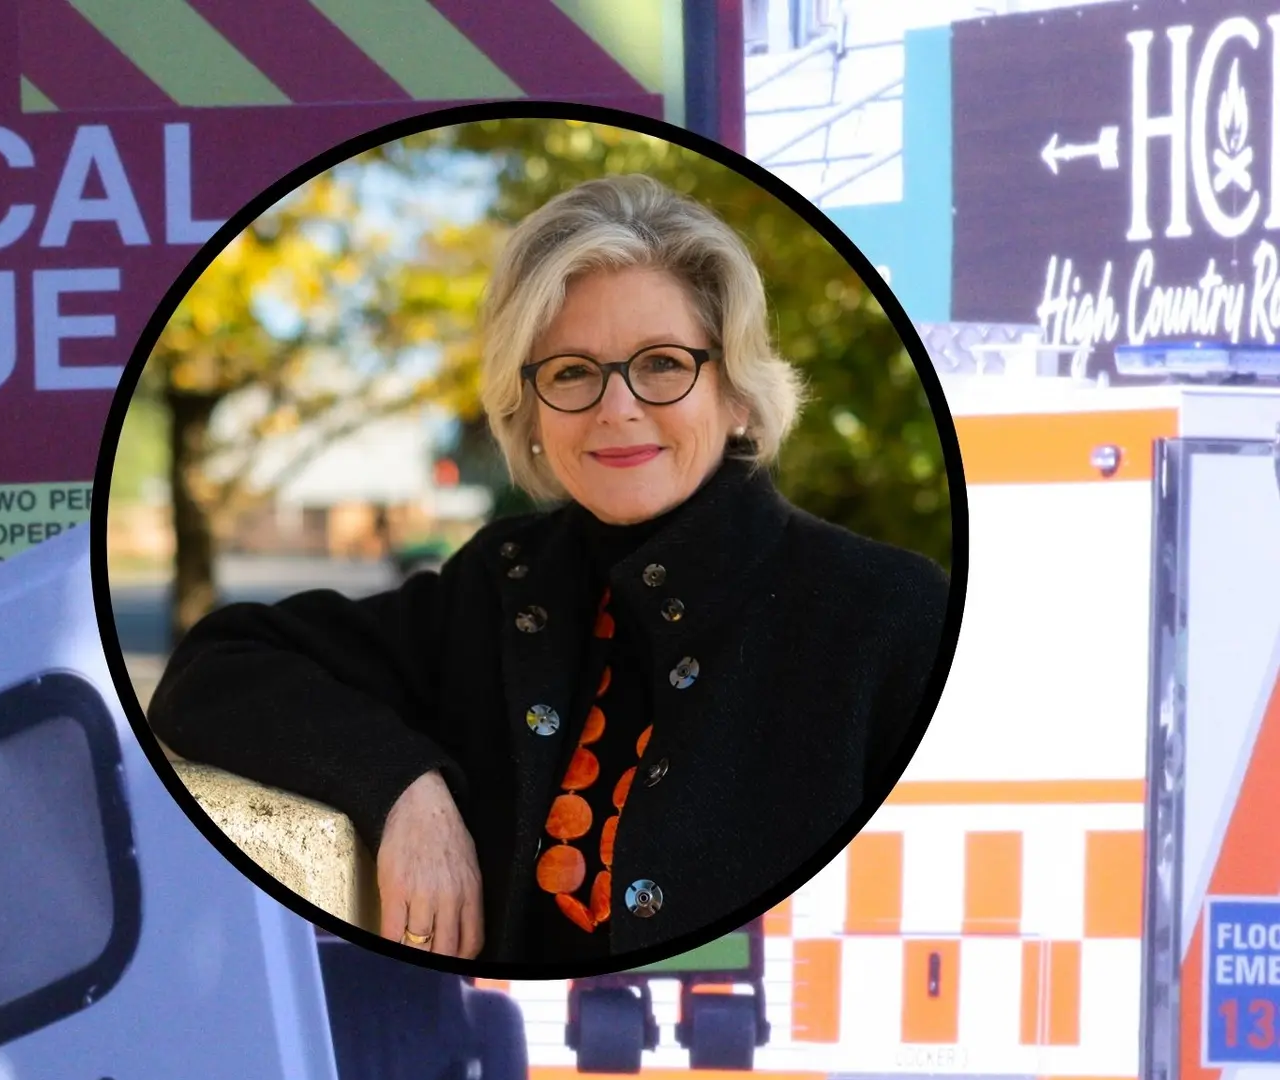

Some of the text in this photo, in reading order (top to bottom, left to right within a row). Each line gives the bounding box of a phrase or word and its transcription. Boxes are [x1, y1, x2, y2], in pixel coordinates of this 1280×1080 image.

[1037, 254, 1120, 381] High
[1127, 248, 1245, 344] Country
[1218, 998, 1280, 1050] 13
